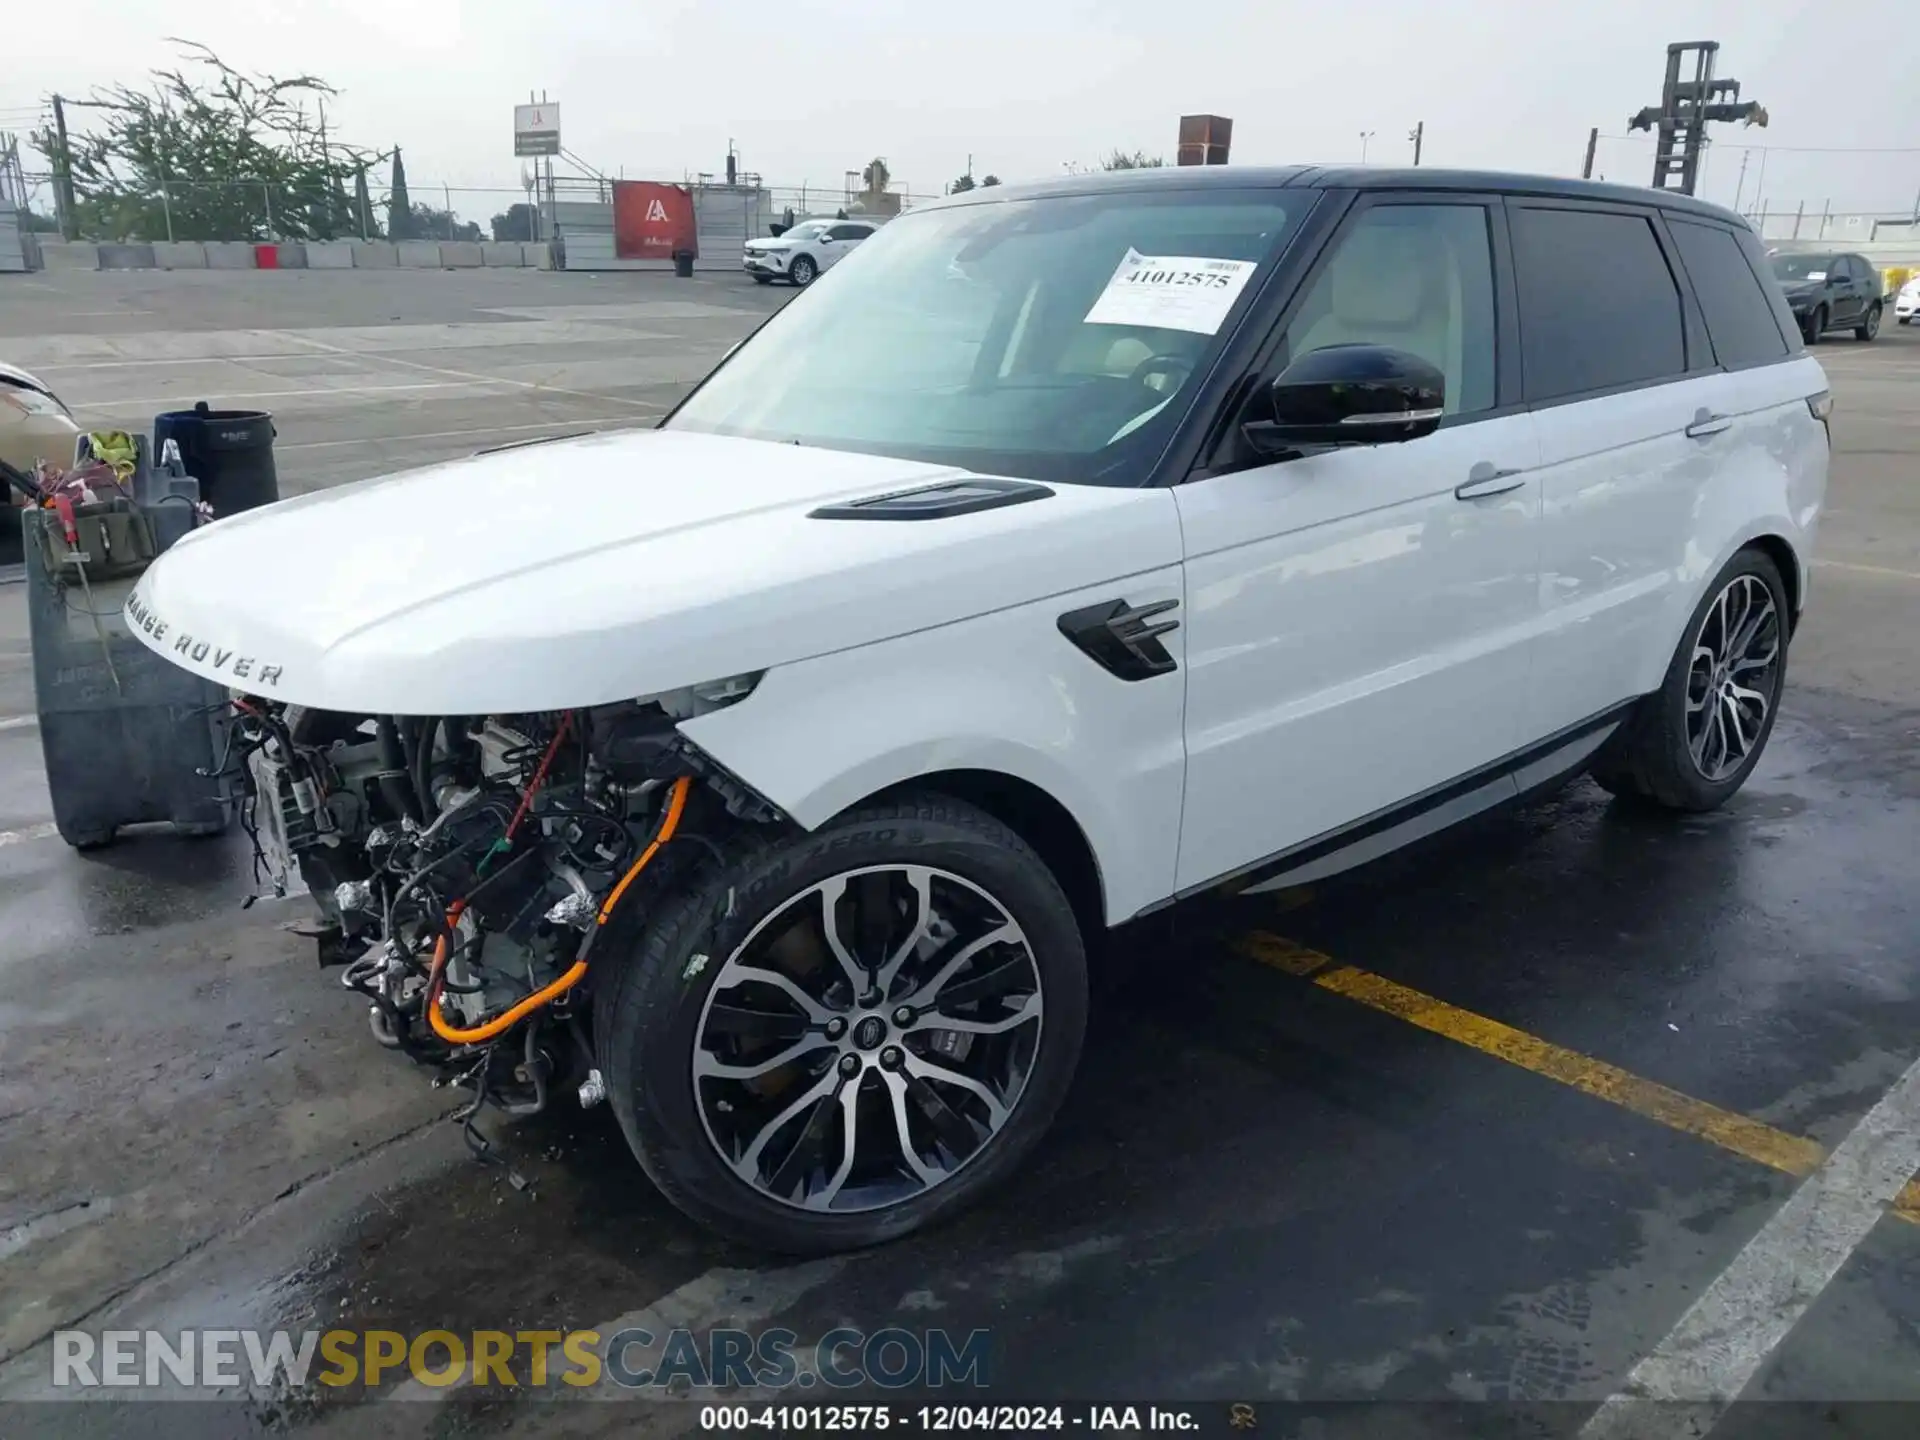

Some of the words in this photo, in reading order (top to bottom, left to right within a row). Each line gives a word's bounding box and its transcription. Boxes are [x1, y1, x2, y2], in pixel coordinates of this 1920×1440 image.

[1126, 270, 1231, 289] 41012575
[127, 592, 168, 641] RANGE
[174, 633, 283, 686] ROVER
